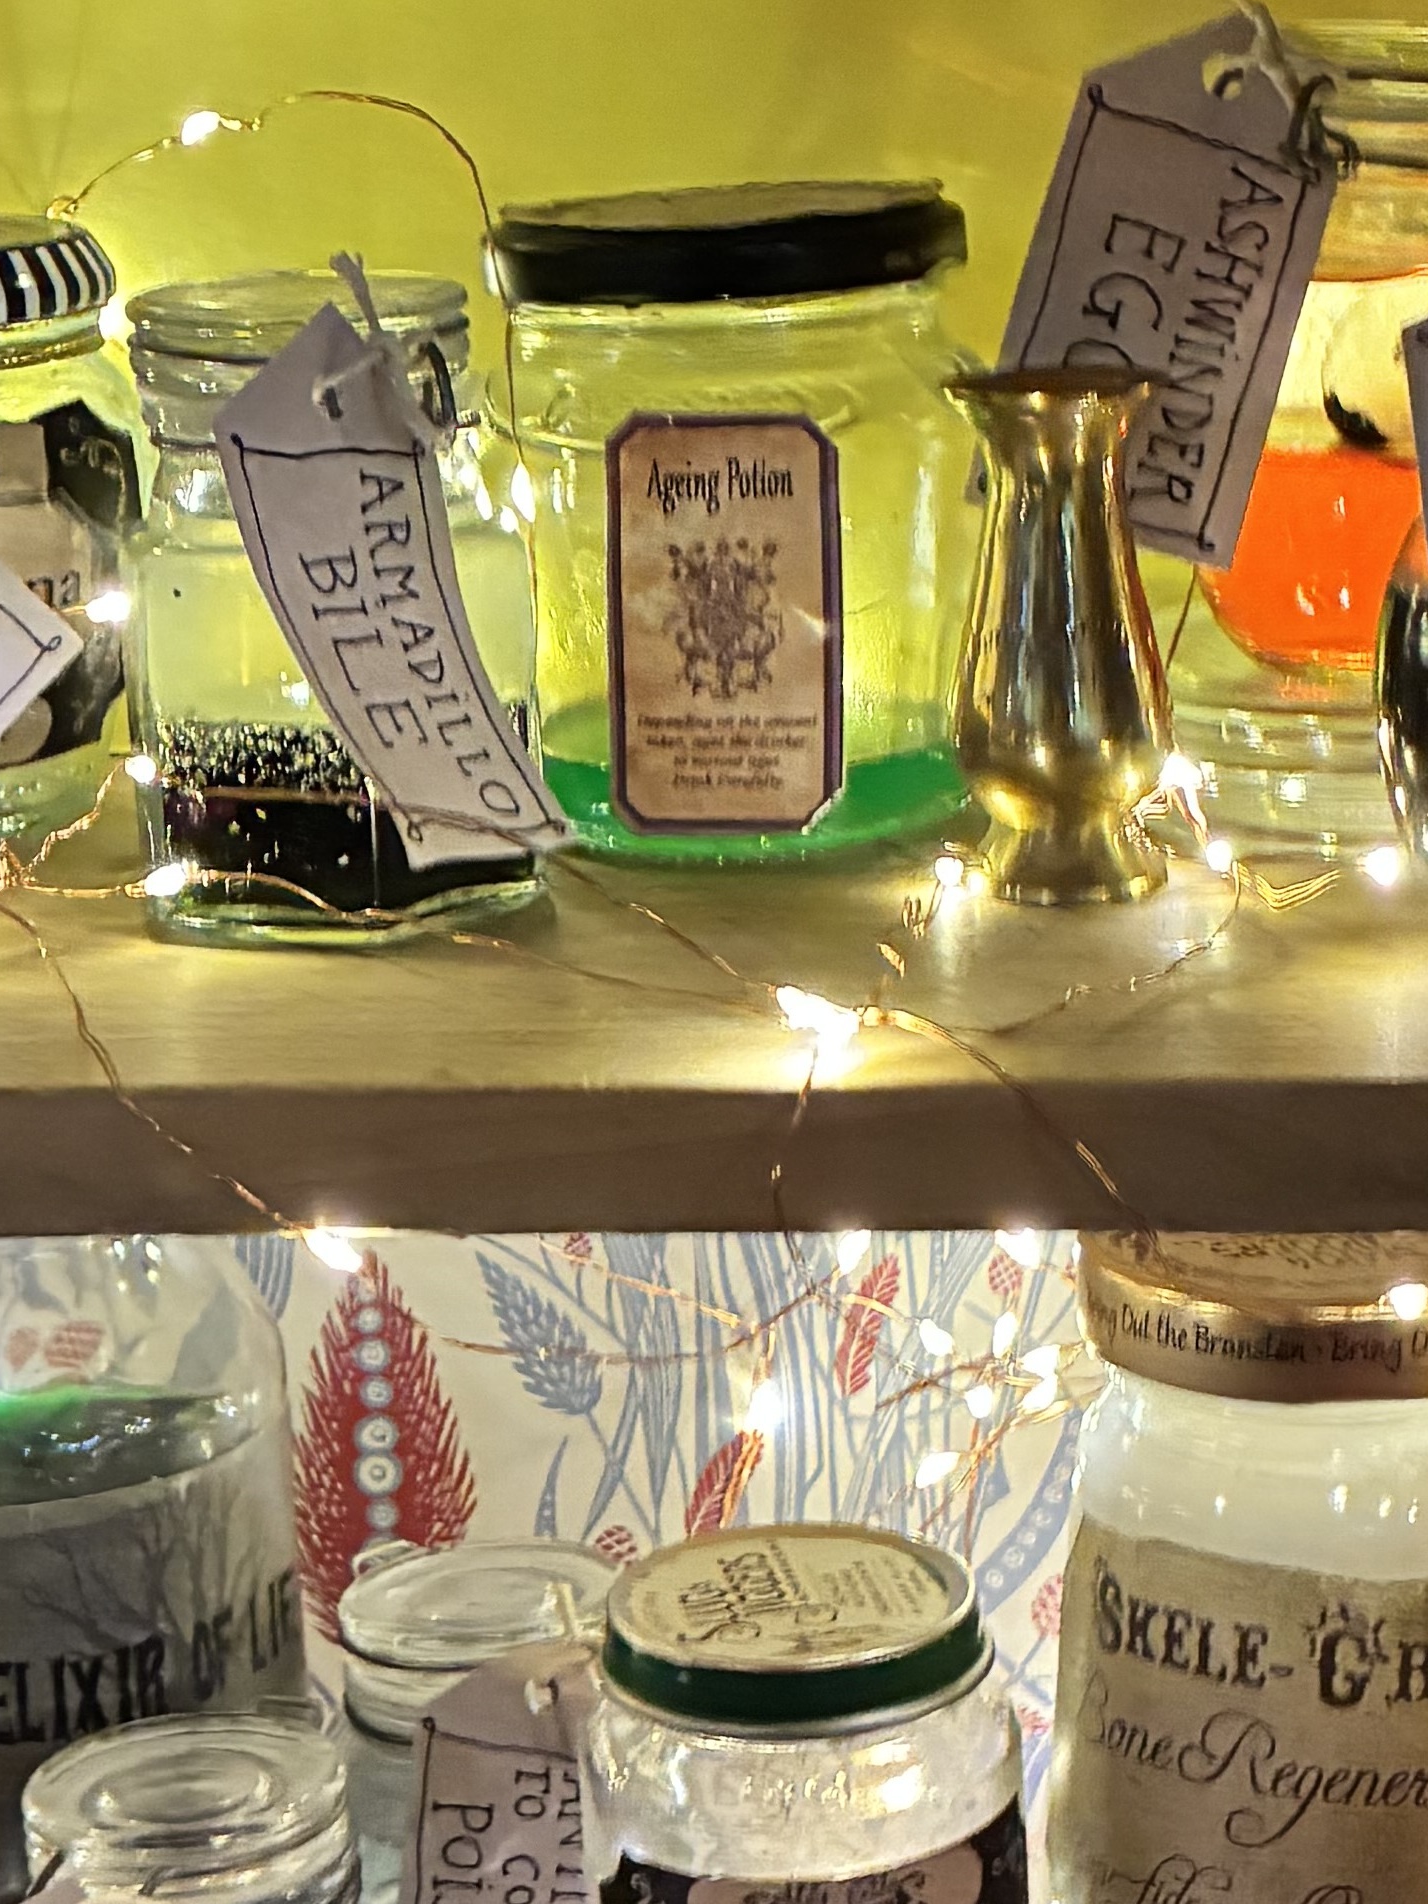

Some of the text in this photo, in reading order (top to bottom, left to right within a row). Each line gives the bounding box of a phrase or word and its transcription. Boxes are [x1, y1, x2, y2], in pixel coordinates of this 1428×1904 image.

[1131, 161, 1283, 506] ASHWINDER
[647, 456, 793, 516] Ageing Potion
[300, 552, 427, 750] BILE
[360, 468, 518, 819] ARMADILLO
[1157, 1310, 1187, 1351] the
[192, 1606, 232, 1702] OF
[248, 1568, 294, 1673] LIF
[515, 1766, 551, 1820] TO
